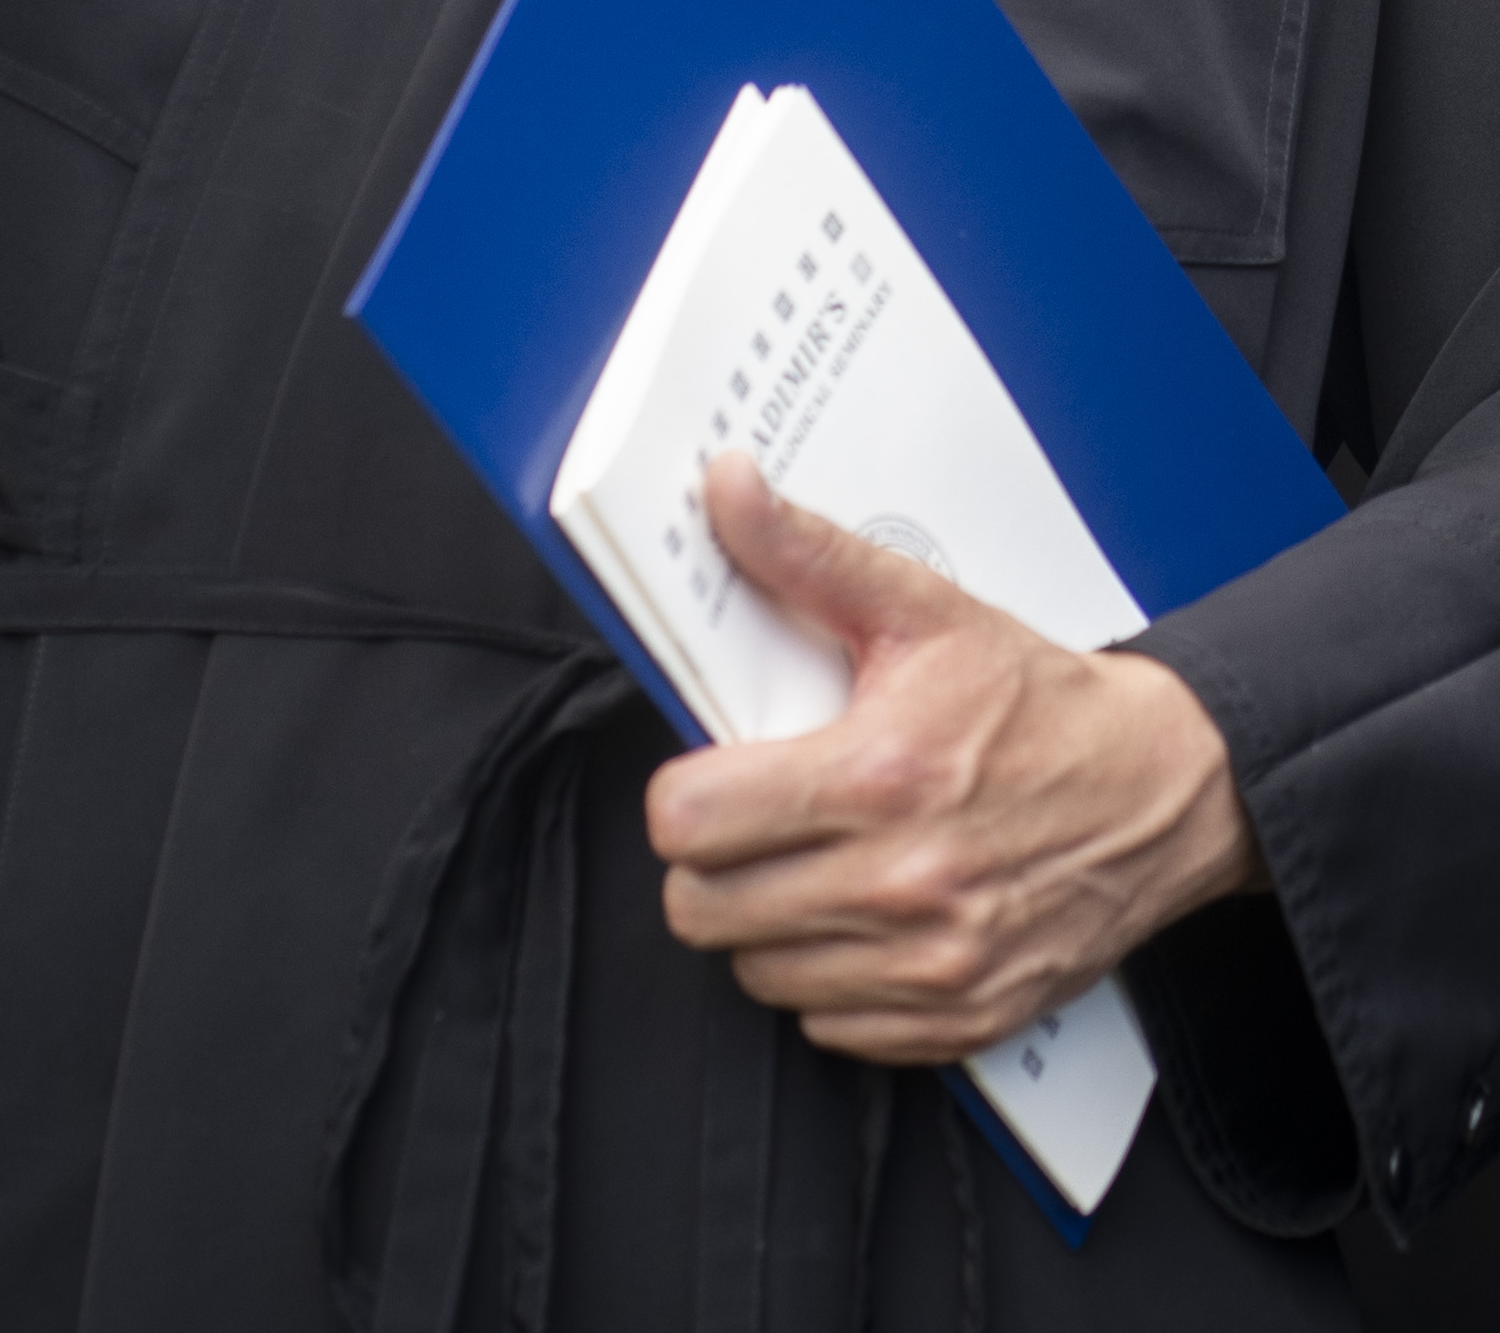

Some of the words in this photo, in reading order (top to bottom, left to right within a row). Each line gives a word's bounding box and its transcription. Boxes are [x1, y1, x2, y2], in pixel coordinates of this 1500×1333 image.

[750, 290, 847, 455] ADIMIR'S
[769, 383, 833, 487] OLOGICAL
[828, 277, 894, 381] SEMINARY
